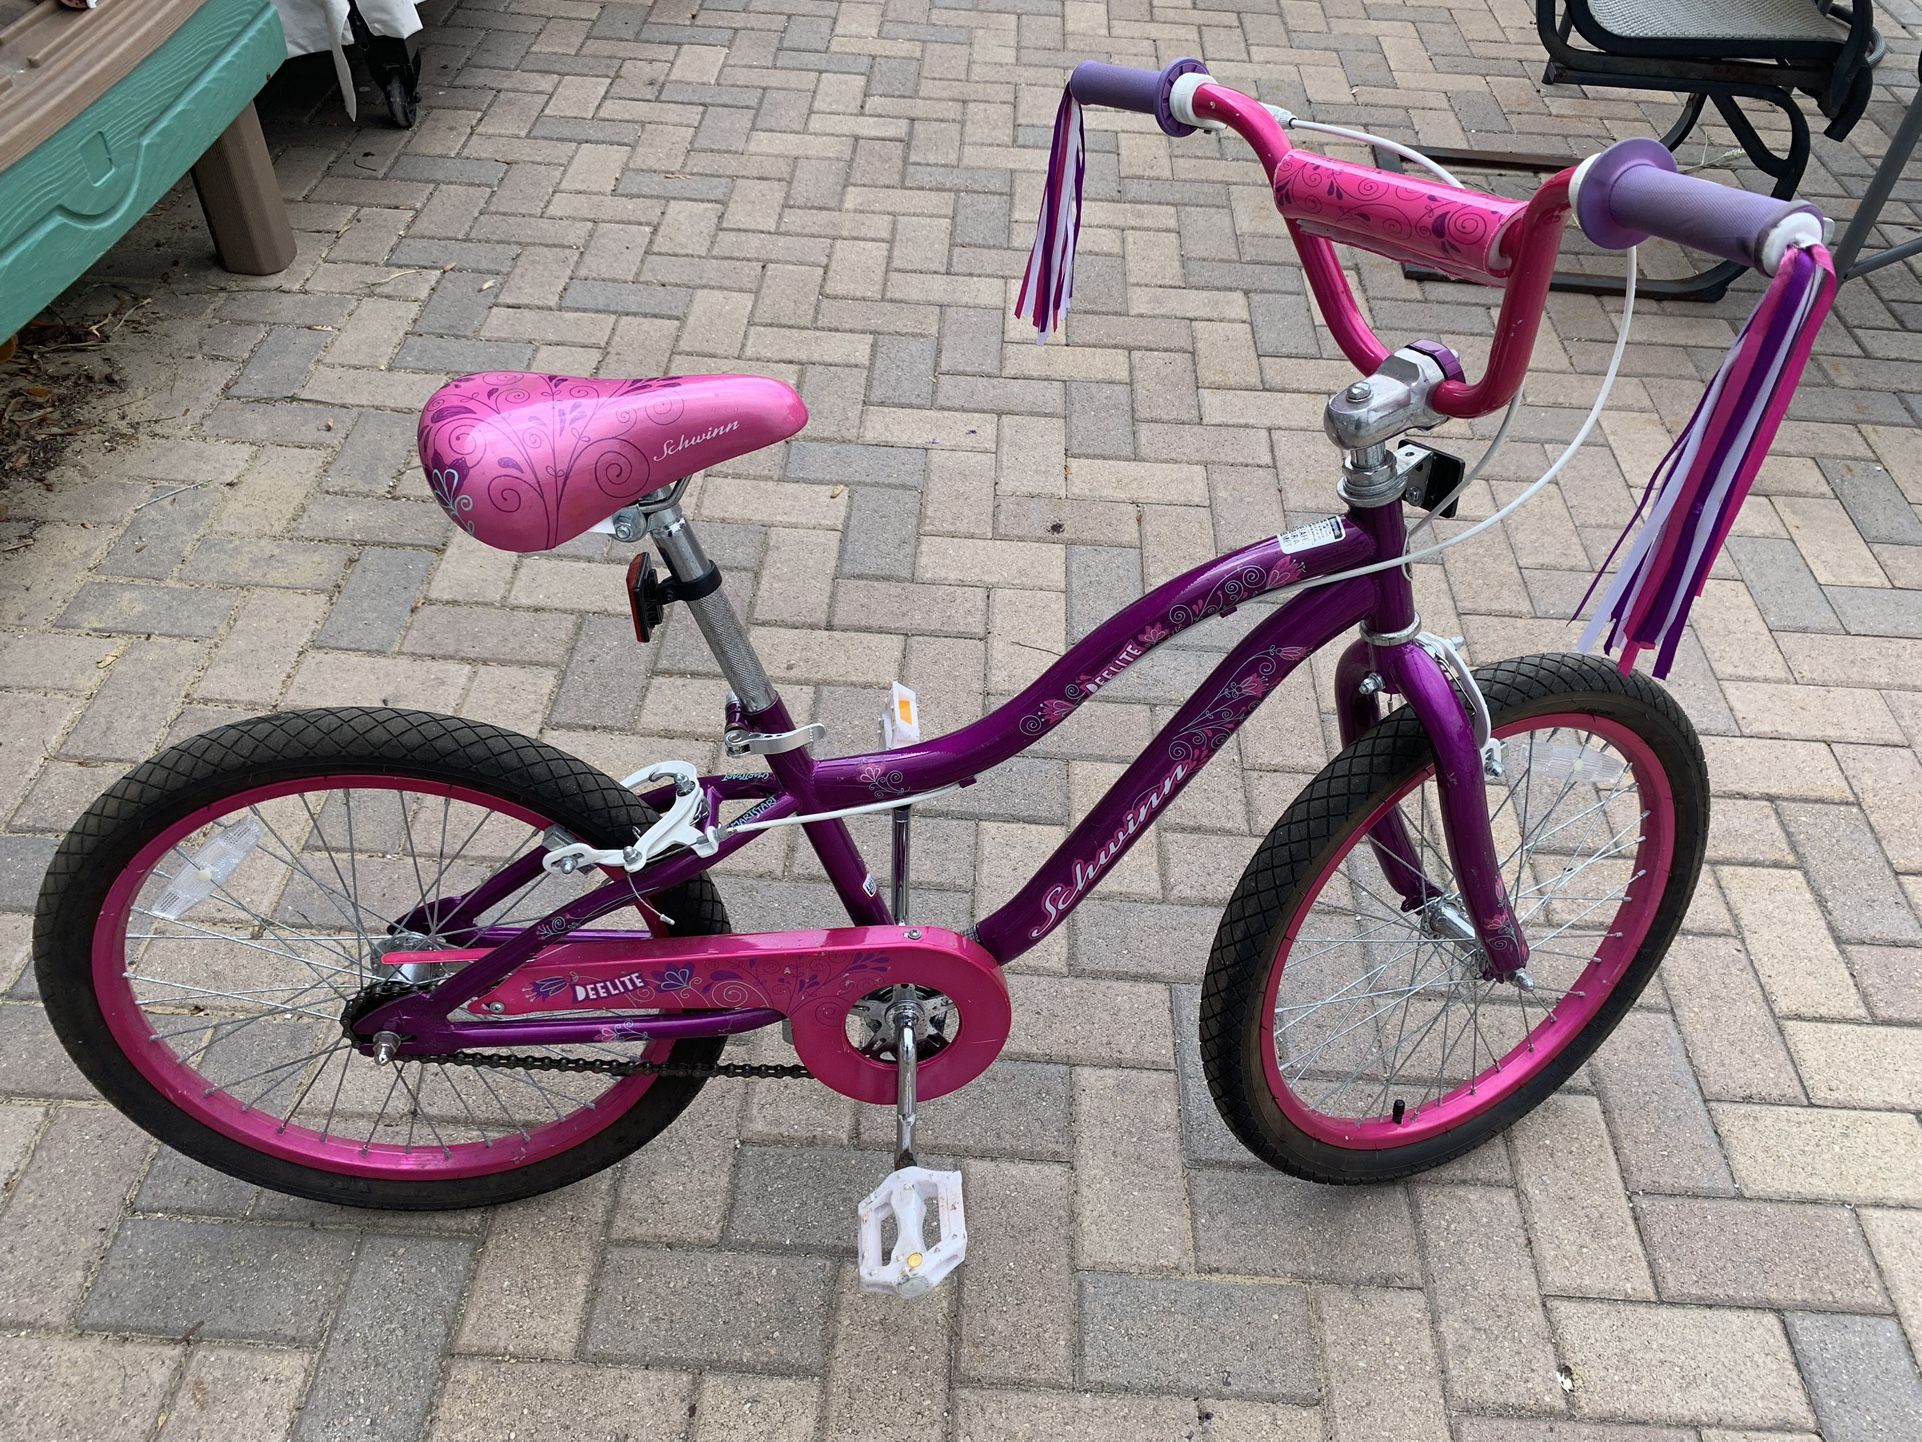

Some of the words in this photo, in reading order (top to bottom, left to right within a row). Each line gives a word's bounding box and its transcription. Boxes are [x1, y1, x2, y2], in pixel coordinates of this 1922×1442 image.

[653, 420, 740, 462] Schwinn
[1086, 644, 1142, 693] DEELITE
[731, 796, 777, 828] MARTSTART
[1031, 763, 1189, 937] Schwinn
[575, 973, 645, 1001] DEELITE
